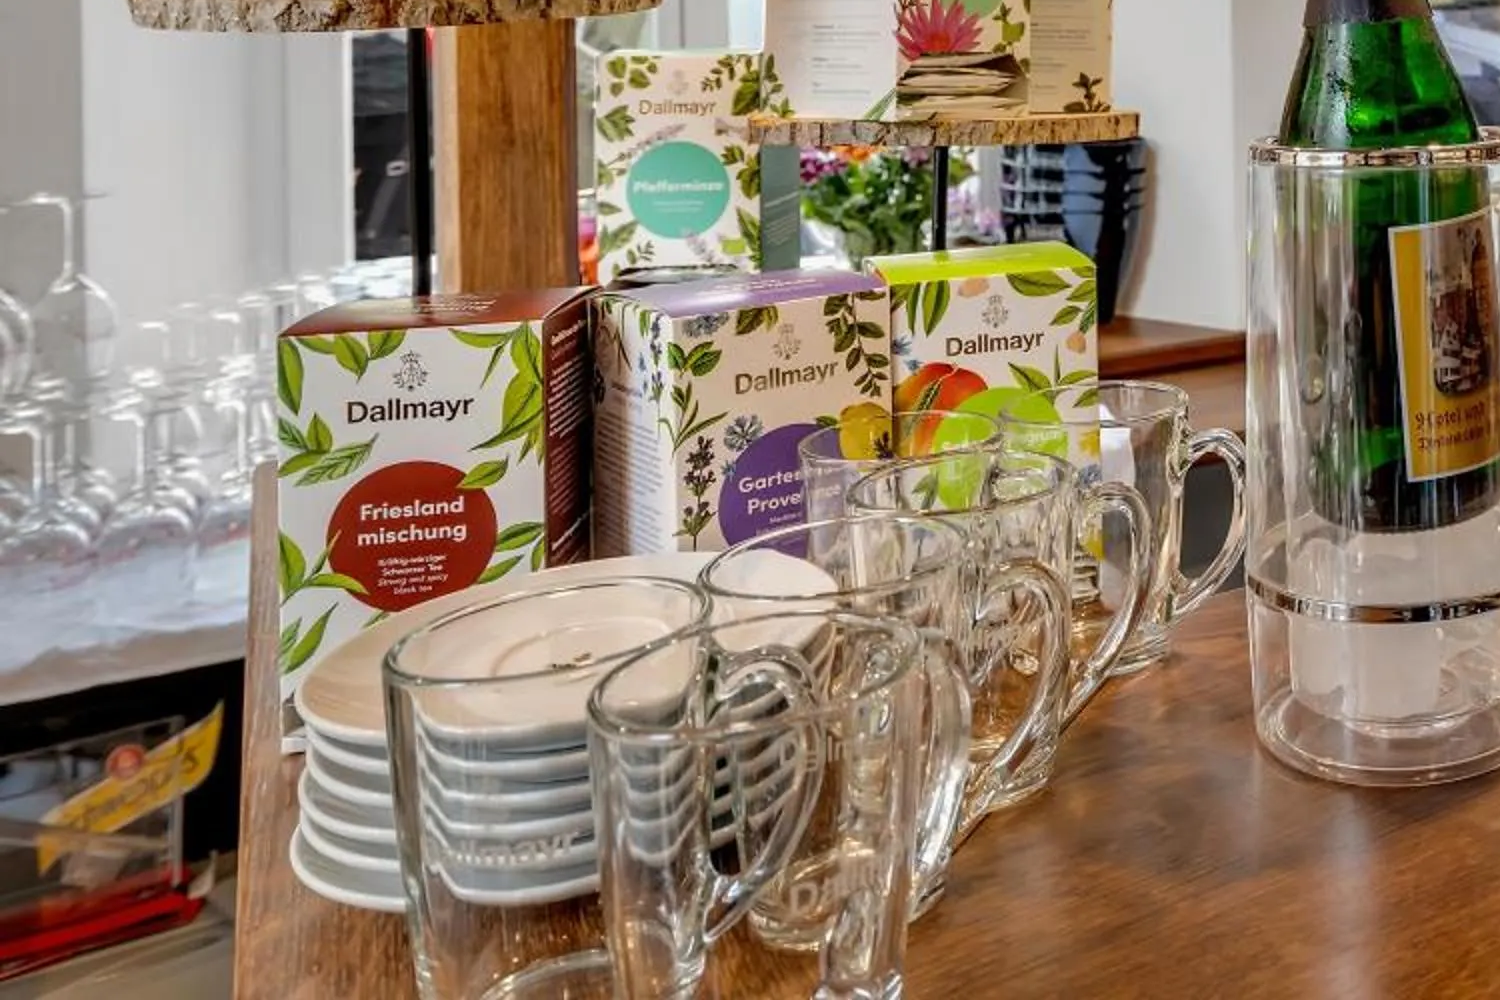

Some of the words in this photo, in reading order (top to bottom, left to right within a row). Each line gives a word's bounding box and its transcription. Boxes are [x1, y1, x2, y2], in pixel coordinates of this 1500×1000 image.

[639, 98, 717, 117] Dallmayr
[945, 332, 1045, 358] Dallmayr
[733, 360, 839, 396] Dallmayr
[347, 396, 475, 427] Dallmayr
[360, 495, 465, 521] Friesland
[357, 523, 468, 547] mischung
